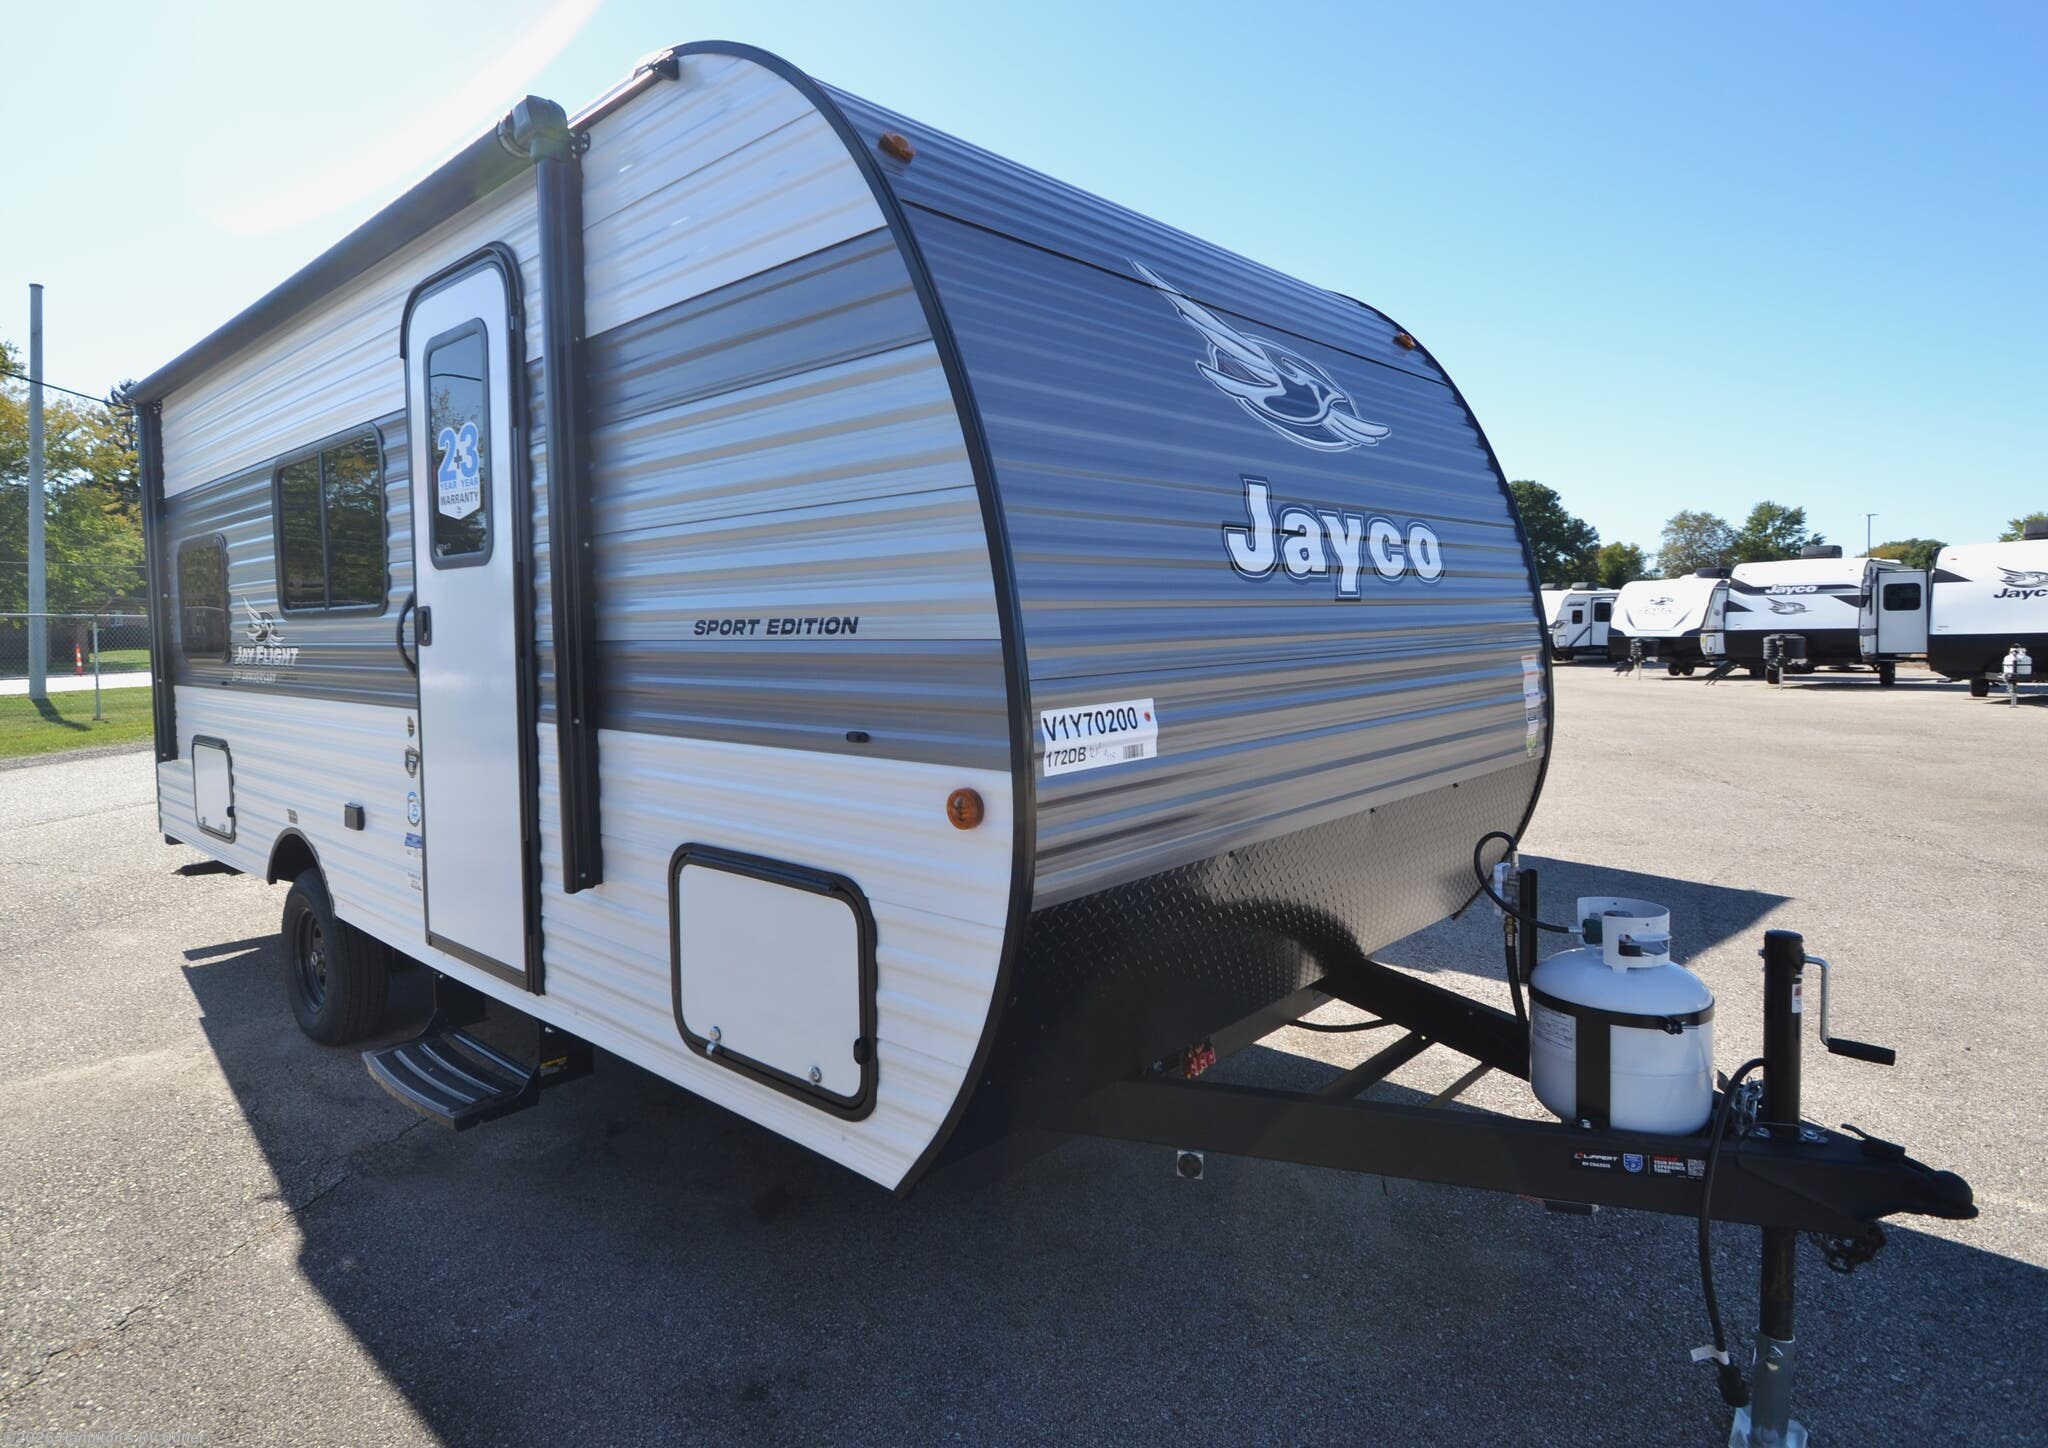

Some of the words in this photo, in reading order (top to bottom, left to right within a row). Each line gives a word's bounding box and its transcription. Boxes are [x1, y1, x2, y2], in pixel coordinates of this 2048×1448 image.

[440, 479, 457, 491] YEAR
[461, 476, 479, 488] YEAR
[440, 491, 479, 506] WARRANTY
[1224, 476, 1444, 599] Jayco
[1765, 584, 1818, 595] Jayco
[693, 618, 760, 636] SPORT
[766, 616, 859, 636] EDITION
[234, 646, 255, 666] JAY
[255, 645, 299, 666] FLIGHT
[1043, 706, 1139, 742] V1Y70200
